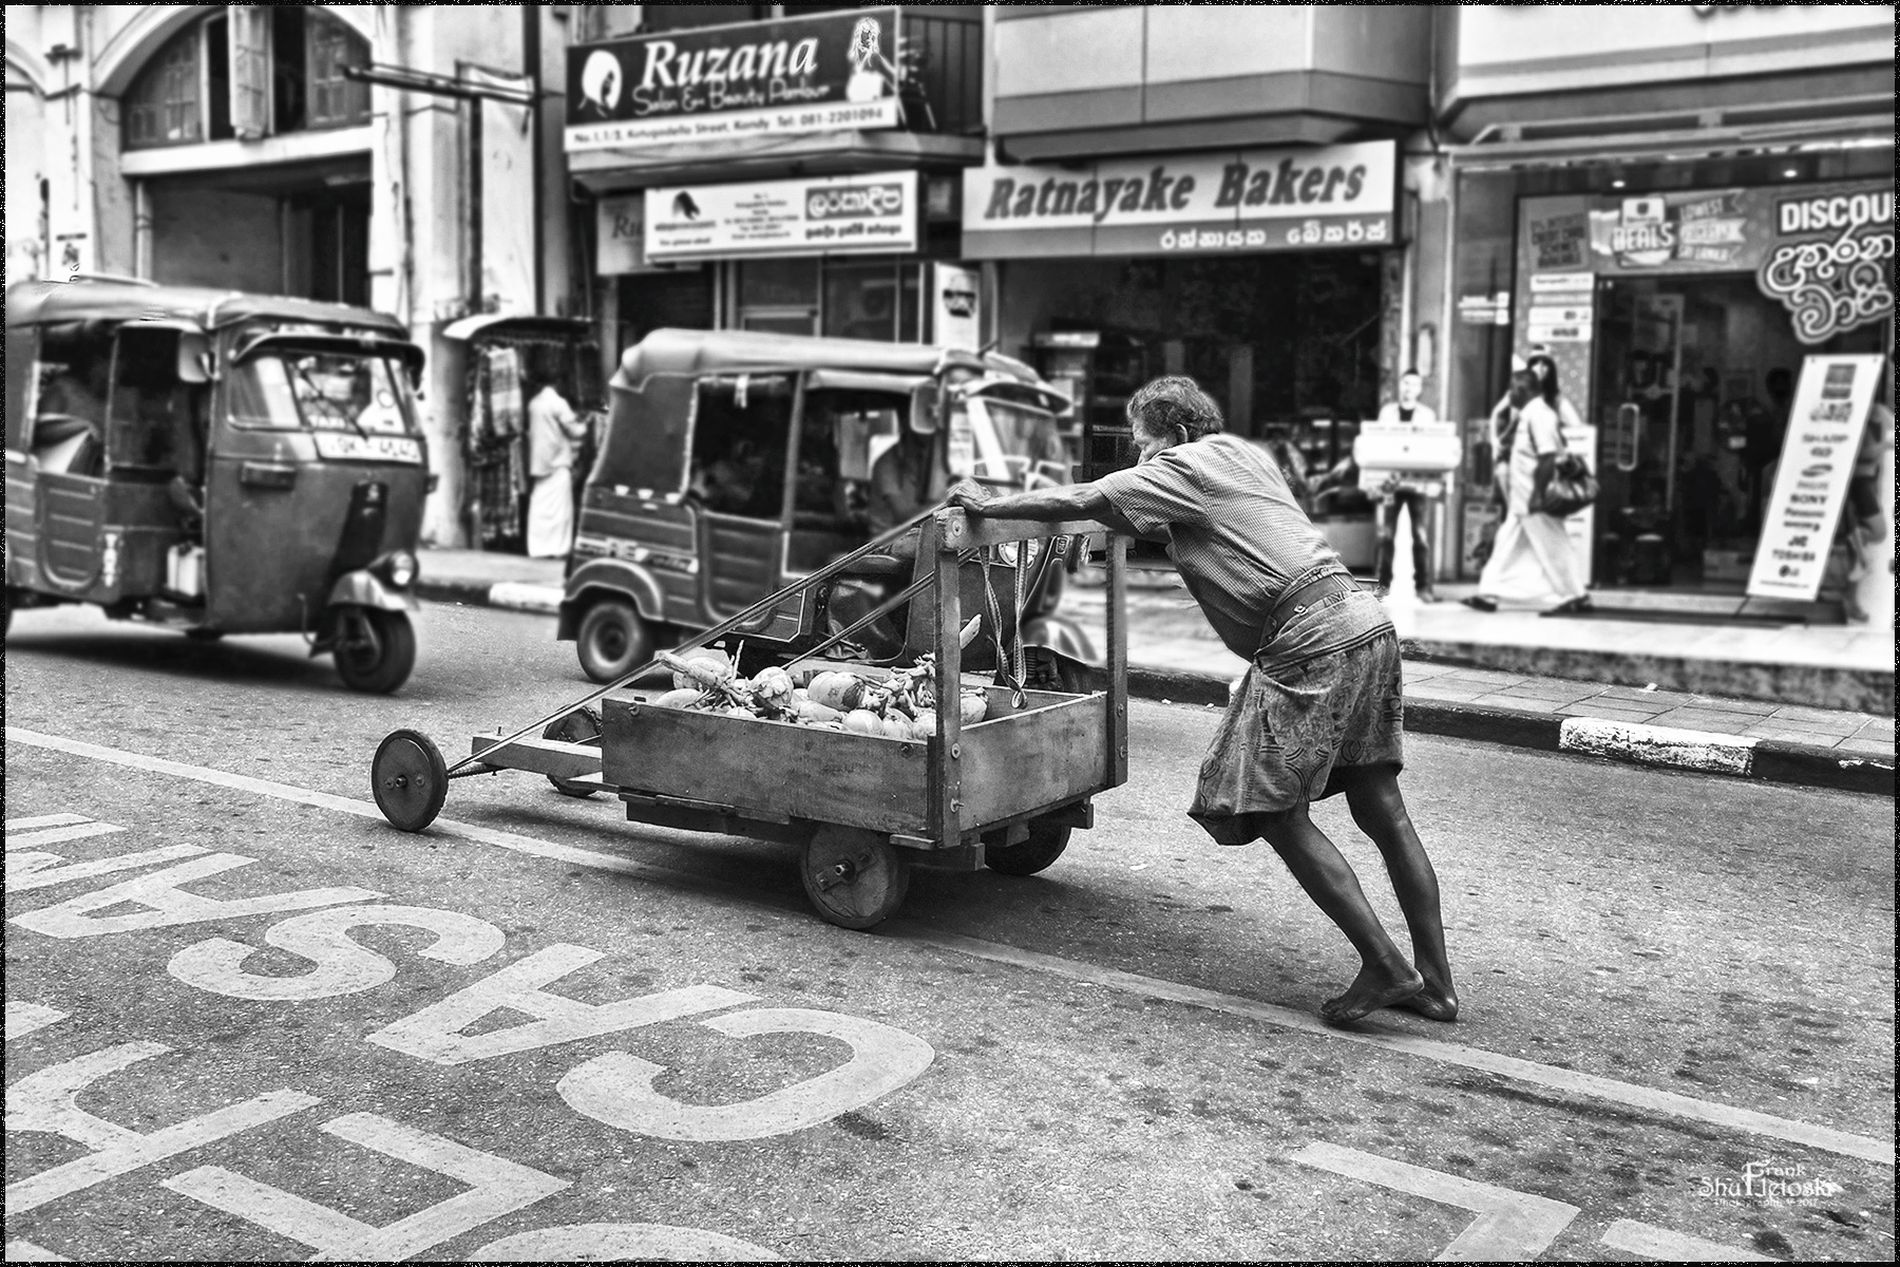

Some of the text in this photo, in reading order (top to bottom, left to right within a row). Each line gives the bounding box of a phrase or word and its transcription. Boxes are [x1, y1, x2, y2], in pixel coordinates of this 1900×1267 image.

[641, 38, 818, 87] Ruzana
[632, 85, 678, 115] Salon
[709, 80, 764, 109] Beauty
[984, 158, 1367, 222] Ratnayake Bakers
[1780, 192, 1895, 233] DISCOU
[1790, 493, 1828, 504] SONY
